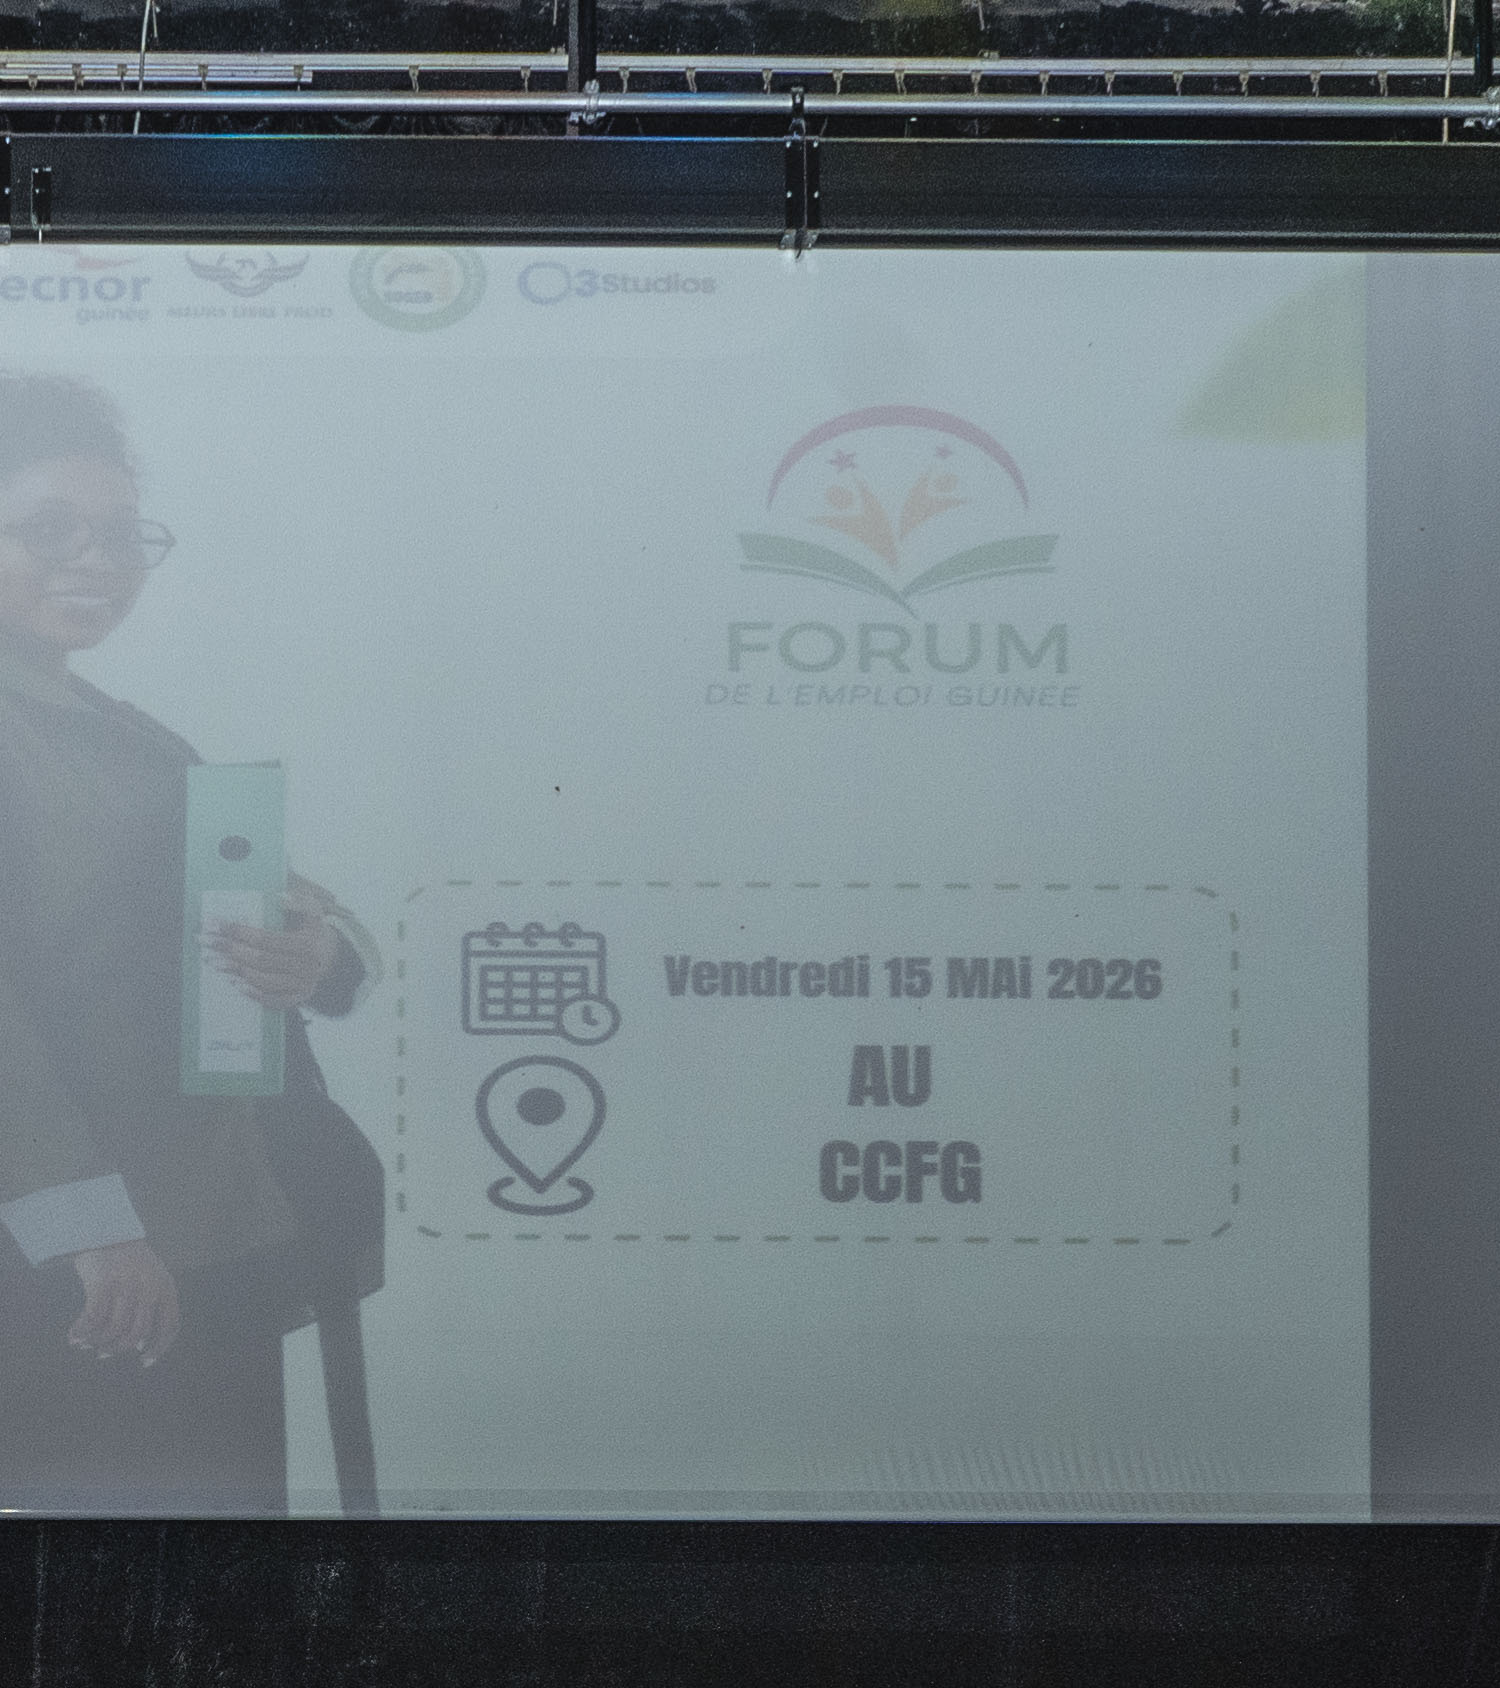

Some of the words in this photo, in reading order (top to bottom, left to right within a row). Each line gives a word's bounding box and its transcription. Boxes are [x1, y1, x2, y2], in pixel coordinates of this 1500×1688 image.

[727, 621, 1071, 675] FORUM
[704, 683, 752, 706] DE
[766, 683, 934, 707] L'EMPLOI
[664, 955, 871, 1000] Vendredi
[884, 957, 933, 1000] 15
[1047, 958, 1164, 1001] 2026
[847, 1044, 933, 1108] AU
[818, 1139, 983, 1204] CCFG
